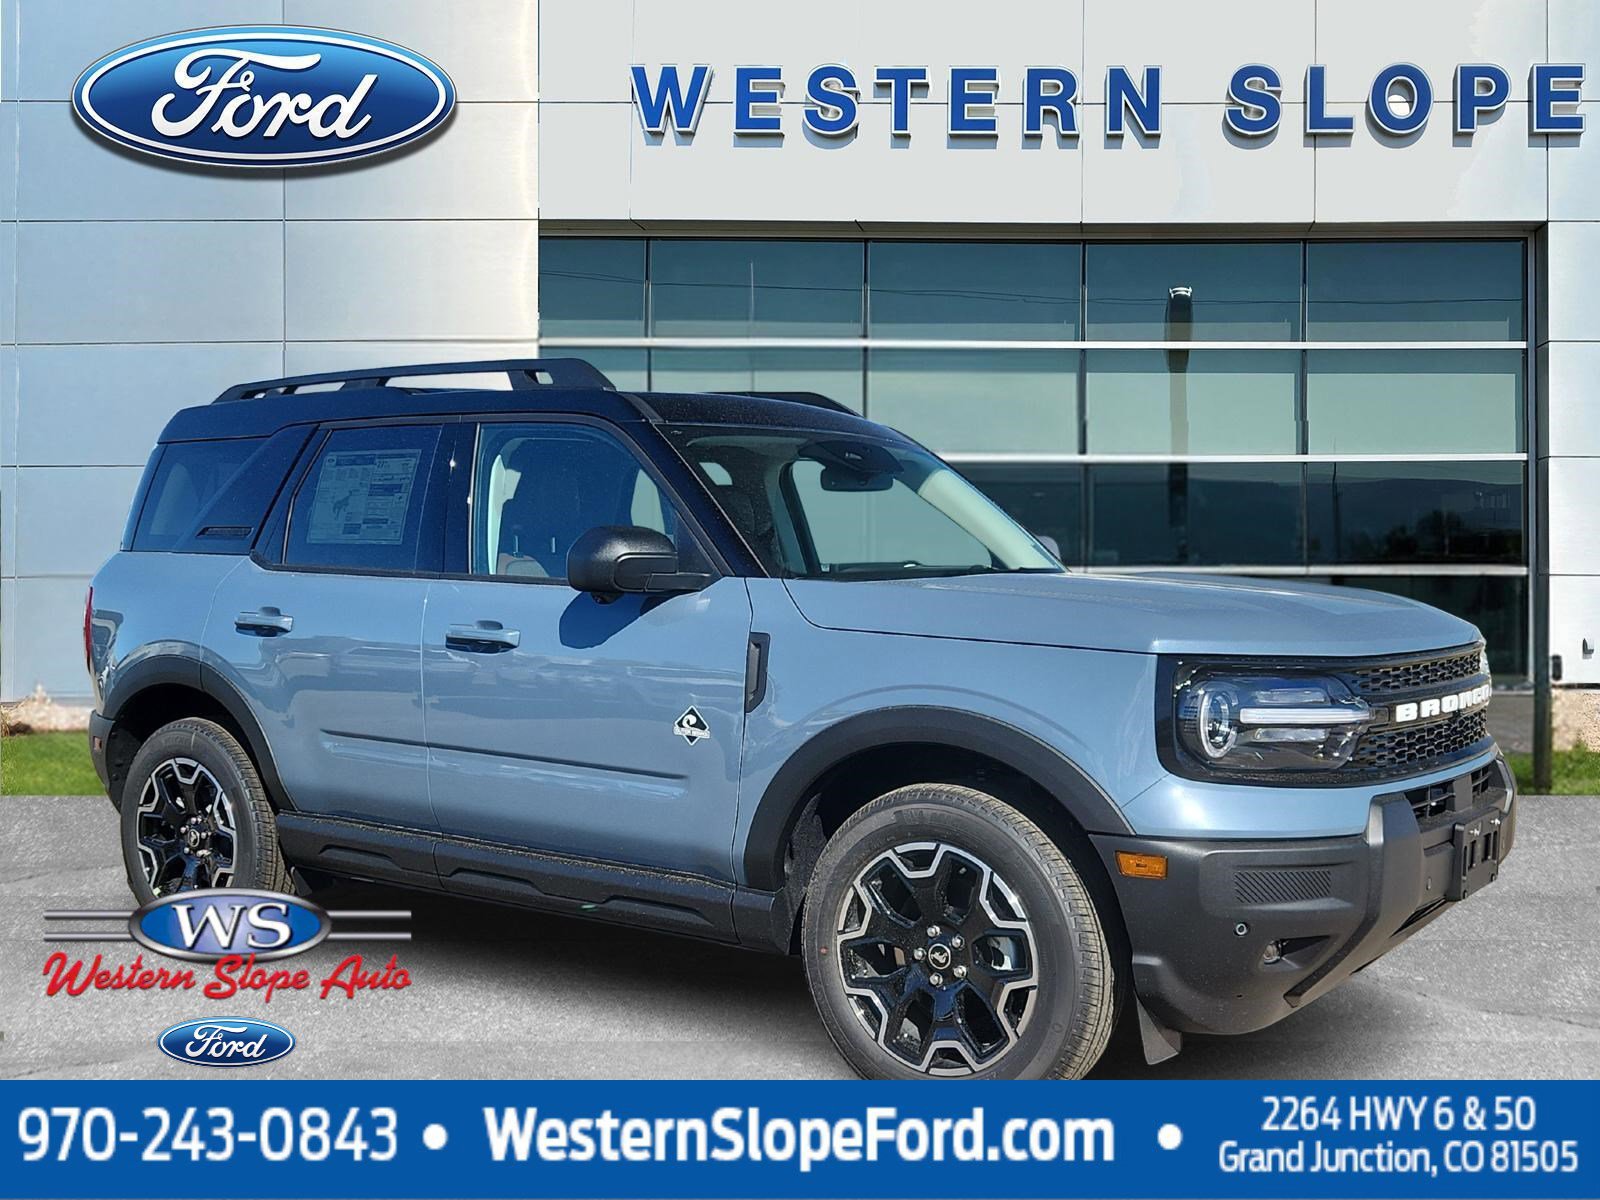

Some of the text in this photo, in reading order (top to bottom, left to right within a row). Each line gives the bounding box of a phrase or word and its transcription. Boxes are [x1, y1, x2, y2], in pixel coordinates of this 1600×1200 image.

[151, 48, 379, 140] Ford
[630, 63, 1587, 137] WESTERN SLOPE
[1395, 683, 1491, 723] BRONCO
